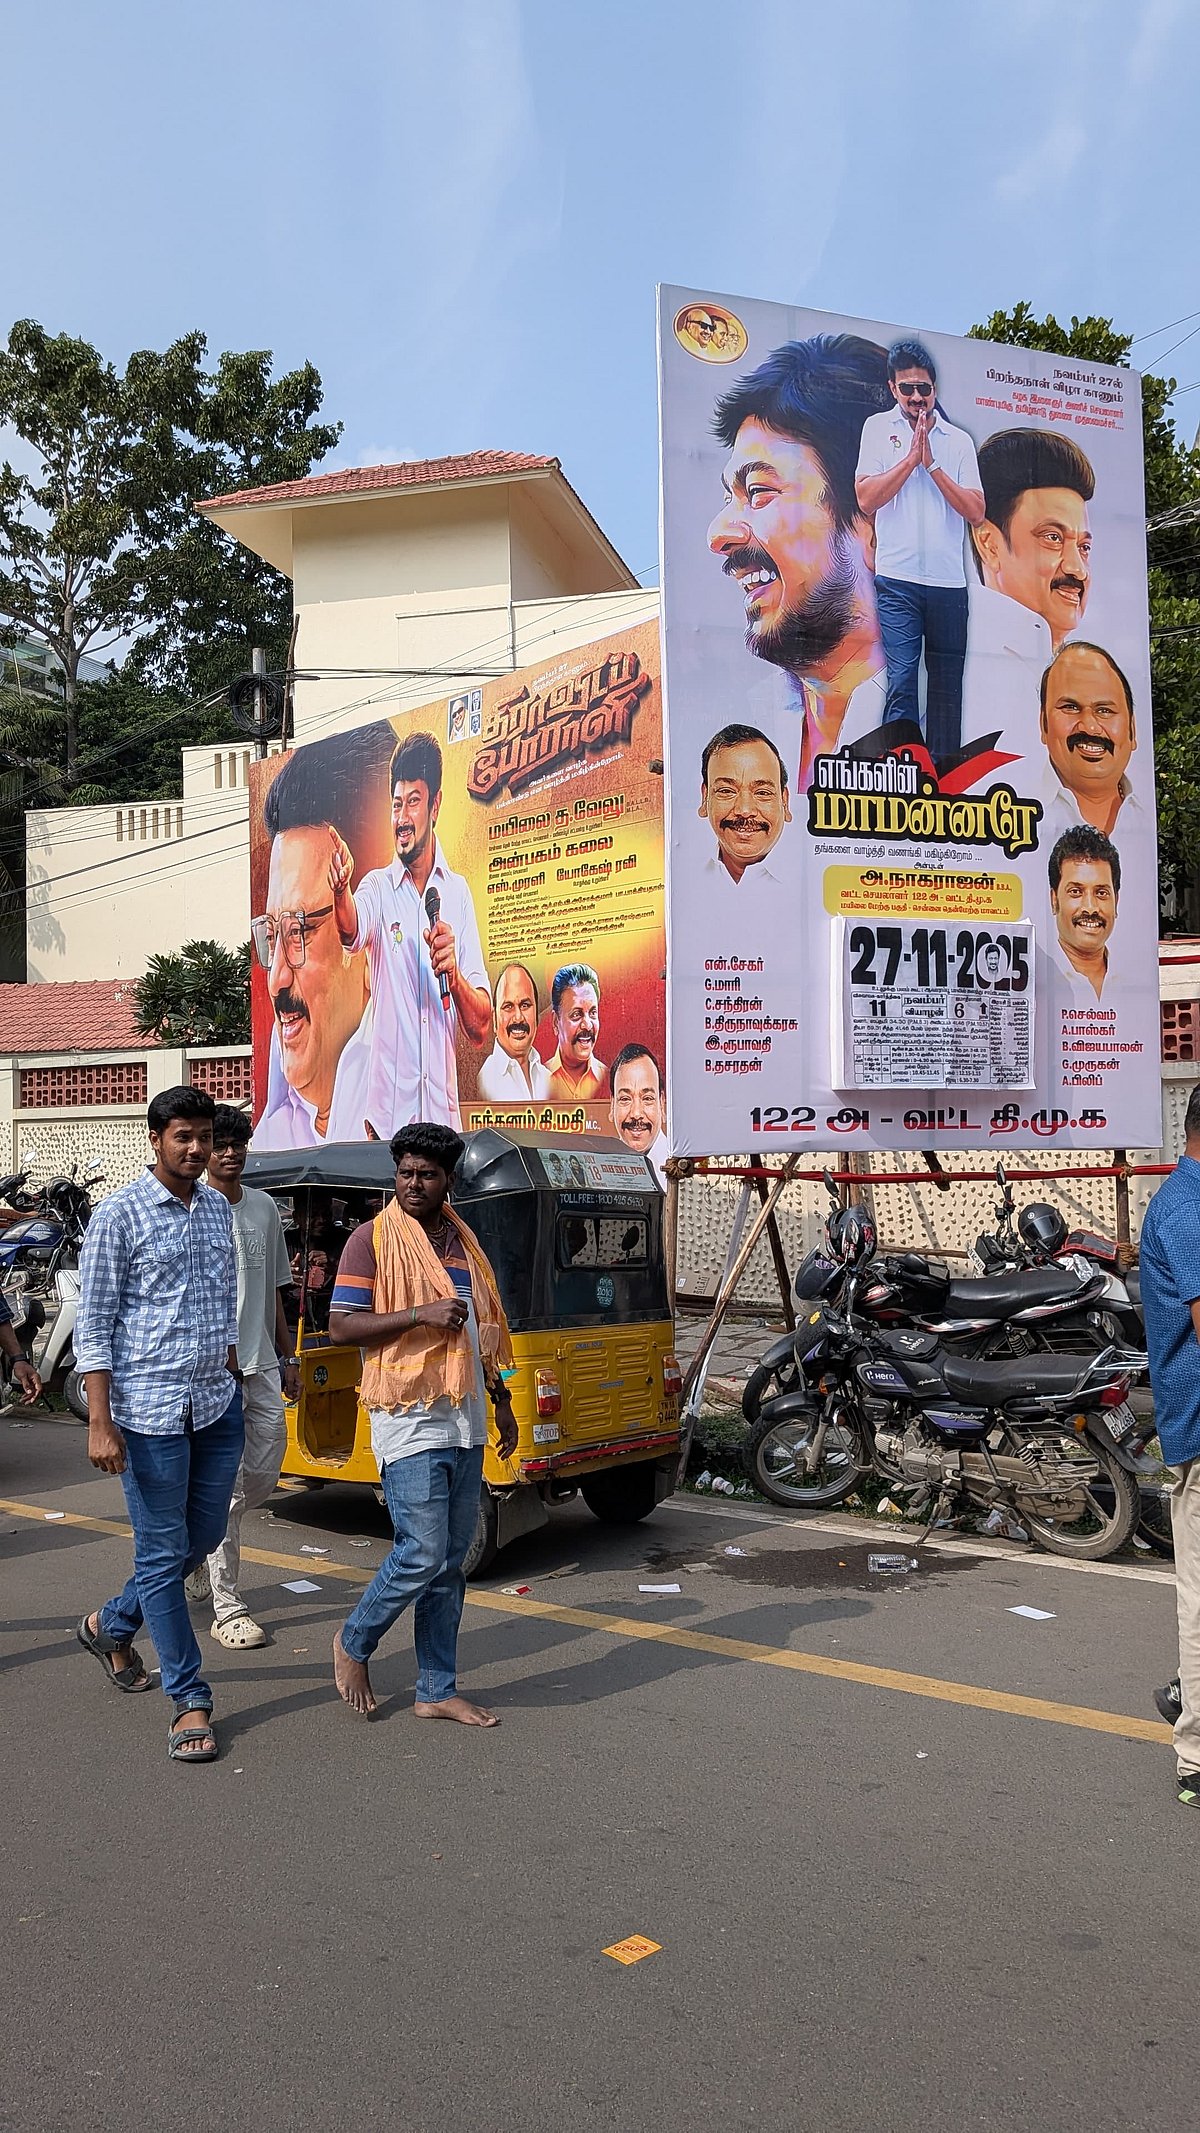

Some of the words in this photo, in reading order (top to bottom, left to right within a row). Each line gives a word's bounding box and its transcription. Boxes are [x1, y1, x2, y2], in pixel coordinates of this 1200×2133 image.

[987, 369, 1050, 390] பிறந்தநாள்
[1053, 382, 1081, 395] விழா
[1084, 389, 1123, 403] காணும்
[1053, 369, 1096, 384] நவம்பர்
[1099, 376, 1123, 389] 27ல்
[818, 752, 918, 794] எங்களின்
[488, 812, 551, 841] மயிலை
[555, 795, 624, 831] த.வேலு
[814, 783, 1038, 852] மாமன்னரே
[488, 843, 561, 872] அன்பகம்
[565, 835, 614, 858] கலை
[814, 844, 851, 856] தங்களை
[853, 845, 885, 859] வாழ்த்தி
[887, 846, 922, 858] வணங்கி
[924, 848, 973, 861] மகிழ்கிறோம்
[487, 872, 545, 894] எஸ்.முரளி
[556, 859, 613, 881] யோகேஷ்
[615, 854, 636, 873] ரவி
[860, 869, 996, 891] அ.நாகராஜன்
[841, 890, 861, 899] வட்ட
[863, 890, 908, 900] செயலாளர்
[912, 893, 927, 901] 122
[930, 894, 939, 902] அ
[946, 894, 964, 903] வட்ட
[966, 895, 993, 905] தி.மு.க
[841, 902, 867, 911] மயிலை
[868, 903, 890, 912] மேற்கு
[891, 902, 908, 912] பகுதி
[912, 903, 941, 913] சென்னை
[942, 904, 980, 914] தென்மேற்கு
[980, 906, 1010, 916] மாவட்டம்
[705, 956, 764, 971] என்.சேகர்
[705, 976, 741, 991] G.மாரி
[705, 996, 763, 1014] C.சந்திரன்
[903, 994, 945, 1005] நவம்பர்
[869, 1000, 886, 1017] 11
[905, 1008, 944, 1019] வியாழன்
[954, 1002, 965, 1019] 6
[1061, 1008, 1116, 1020] P.செல்வம்
[1061, 1023, 1115, 1035] A.பாஸ்கர்
[1062, 1040, 1144, 1052] B.விஜயபாலன்
[705, 1056, 763, 1076] B.தசரதன்
[1062, 1058, 1120, 1072] G.முருகன்
[1062, 1074, 1103, 1086] A.பிலிப்
[470, 1109, 537, 1130] நந்தனம்
[539, 1108, 585, 1133] கி.மதி
[750, 1106, 816, 1132] 122
[826, 1106, 870, 1132] அ
[903, 1106, 982, 1131] வட்ட
[989, 1103, 1108, 1138] தி.மு.க
[589, 1164, 603, 1181] 18
[907, 1337, 925, 1351] Hero
[875, 1372, 895, 1381] Hero
